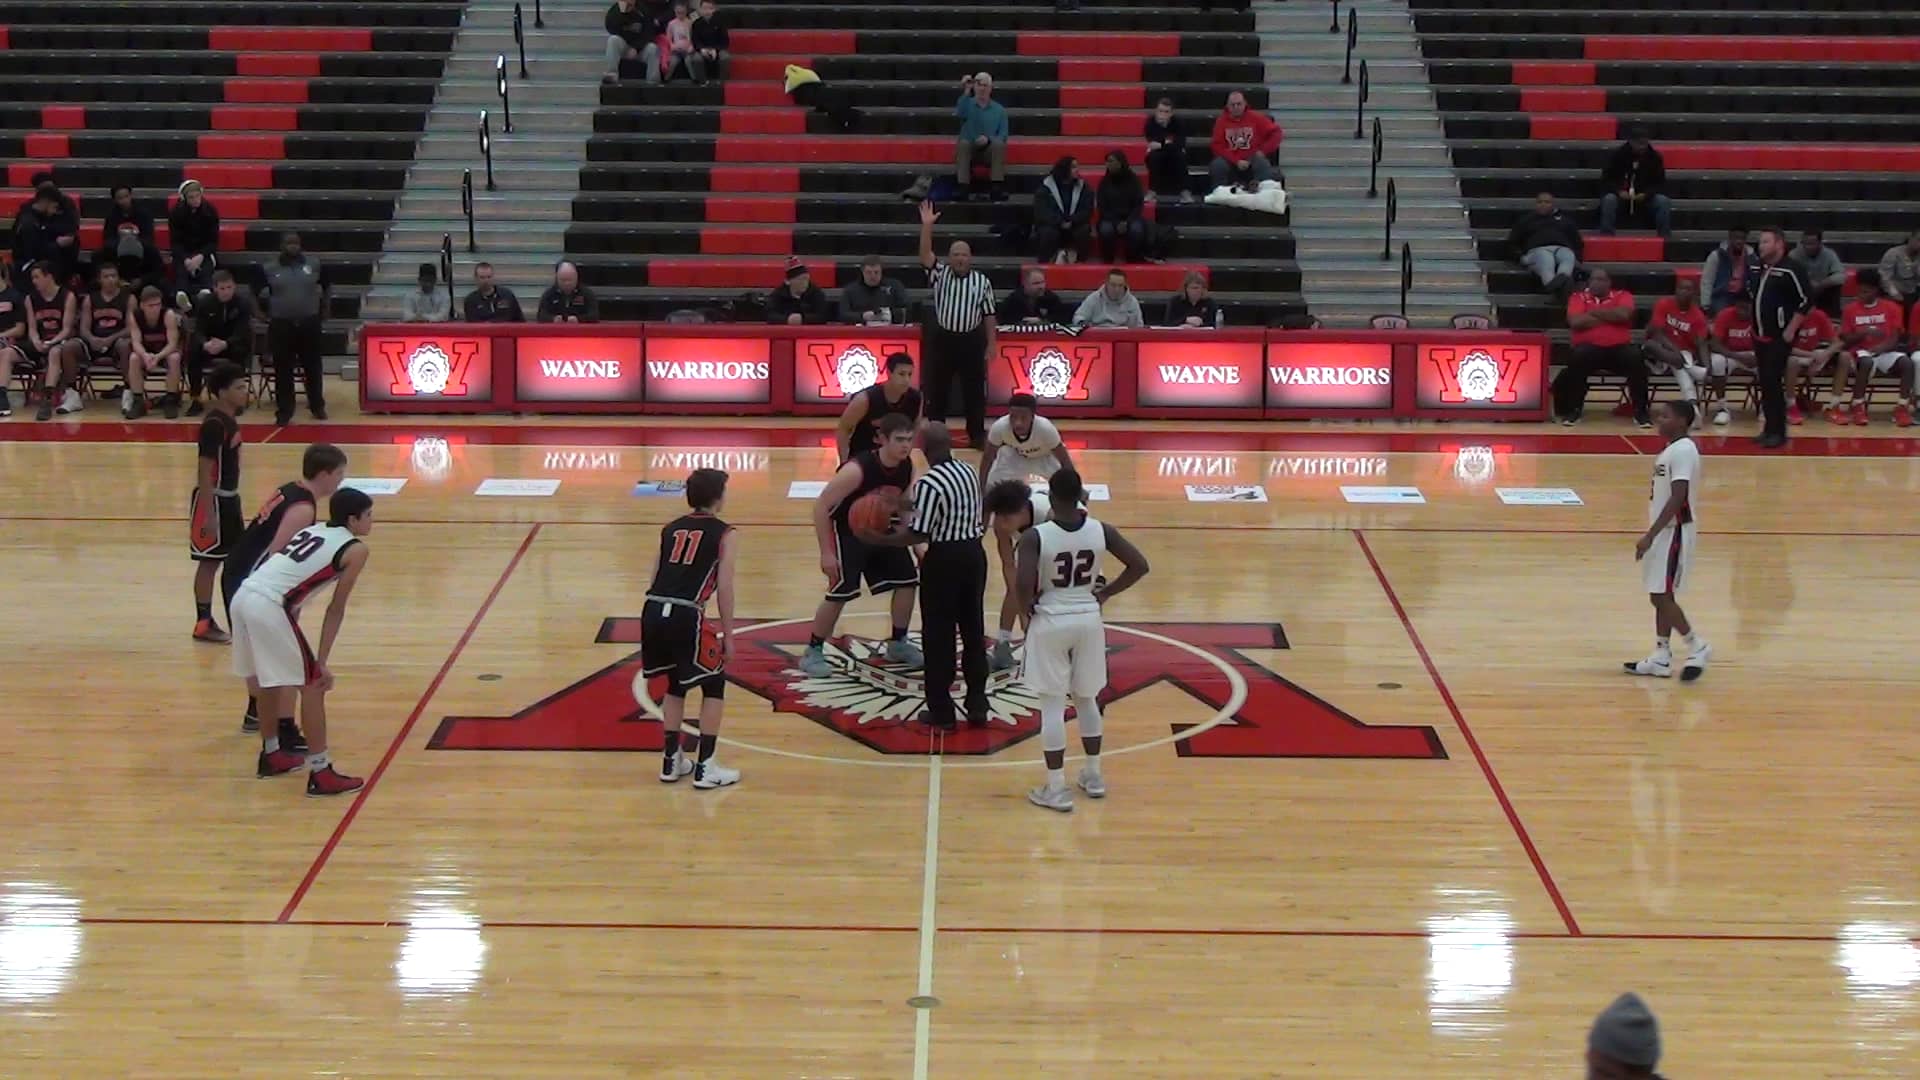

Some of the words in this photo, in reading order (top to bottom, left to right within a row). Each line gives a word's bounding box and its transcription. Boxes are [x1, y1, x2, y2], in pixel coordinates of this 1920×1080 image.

[379, 341, 479, 396] W
[539, 359, 621, 379] WAYNE
[648, 361, 769, 380] WARRIORS
[1158, 365, 1241, 385] WAYNE
[1269, 367, 1391, 386] WARRIORS
[1430, 349, 1528, 403] W
[281, 530, 326, 563] 20
[668, 528, 705, 565] 11
[1050, 549, 1096, 588] 32
